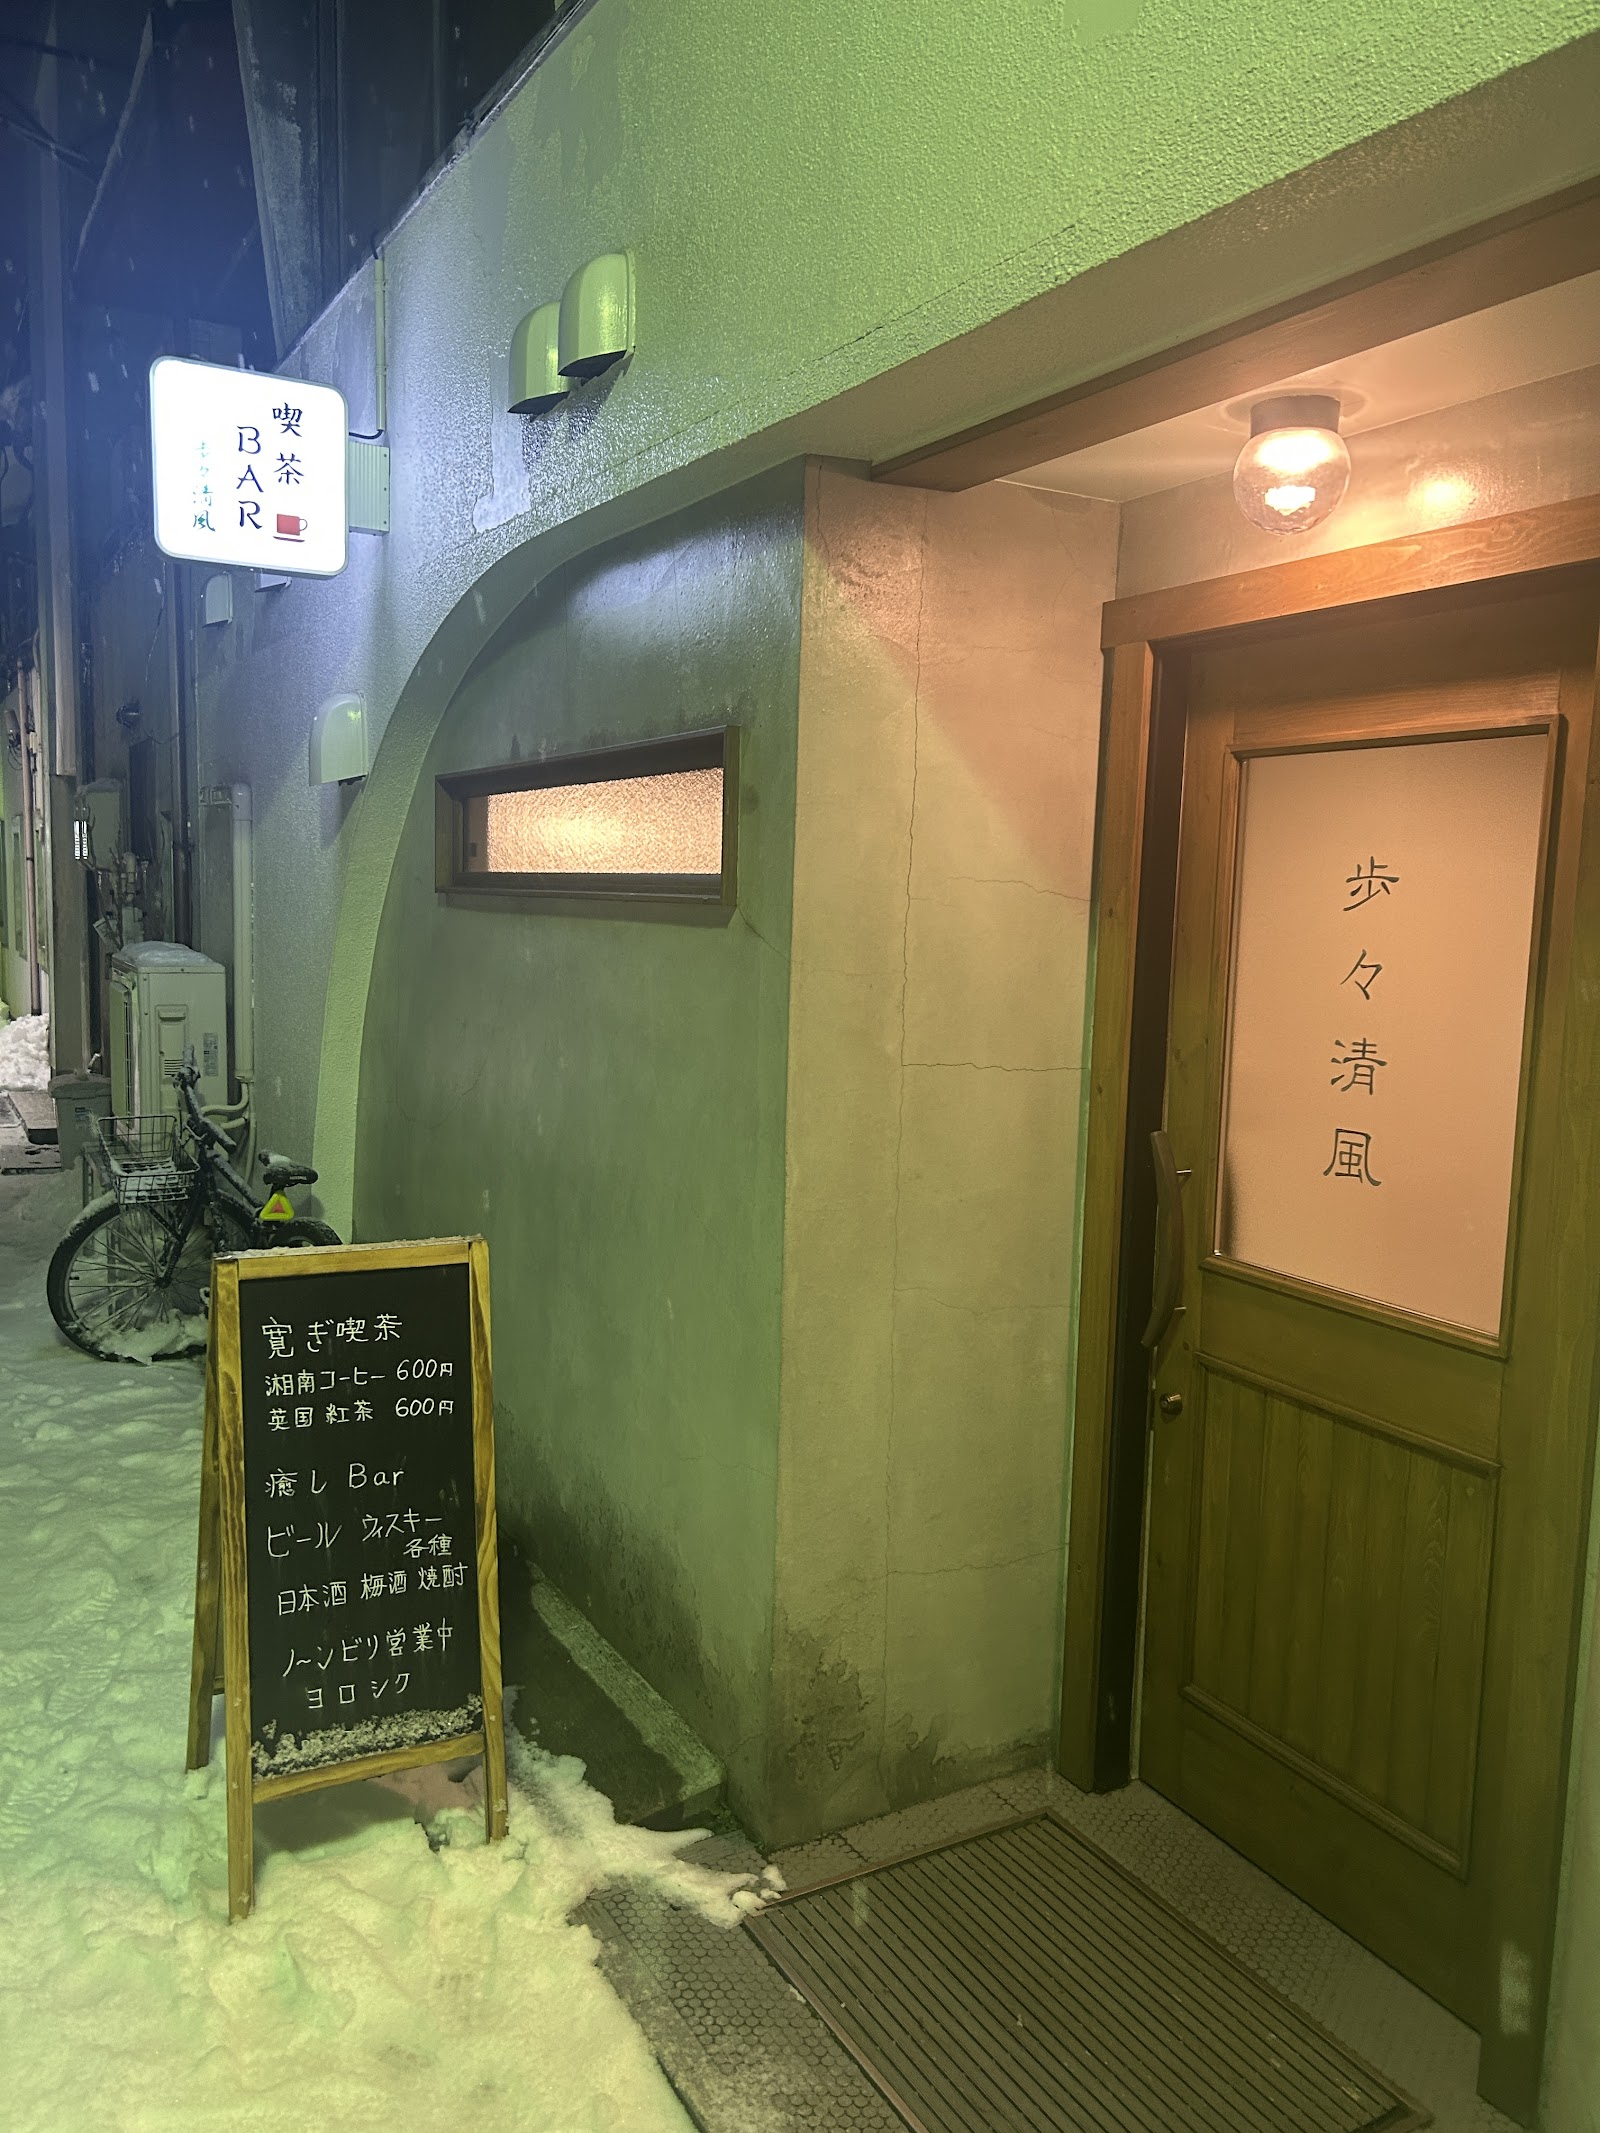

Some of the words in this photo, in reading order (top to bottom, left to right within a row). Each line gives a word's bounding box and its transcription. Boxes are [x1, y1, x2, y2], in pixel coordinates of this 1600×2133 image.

[272, 402, 305, 485] 喫茶
[236, 425, 264, 529] BAR
[1323, 855, 1400, 1187] 歩々清風
[265, 1366, 386, 1397] 湘南コーヒー
[396, 1358, 454, 1381] 600円
[395, 1397, 455, 1418] 600円
[264, 1468, 328, 1498] 癒し
[348, 1463, 405, 1489] Bar
[267, 1521, 343, 1557] ビール
[403, 1533, 453, 1558] 各種
[277, 1581, 347, 1616] 日本酒
[360, 1569, 408, 1600] 梅酒
[417, 1561, 469, 1591] 焼酎
[307, 1672, 411, 1710] ヨロシク
